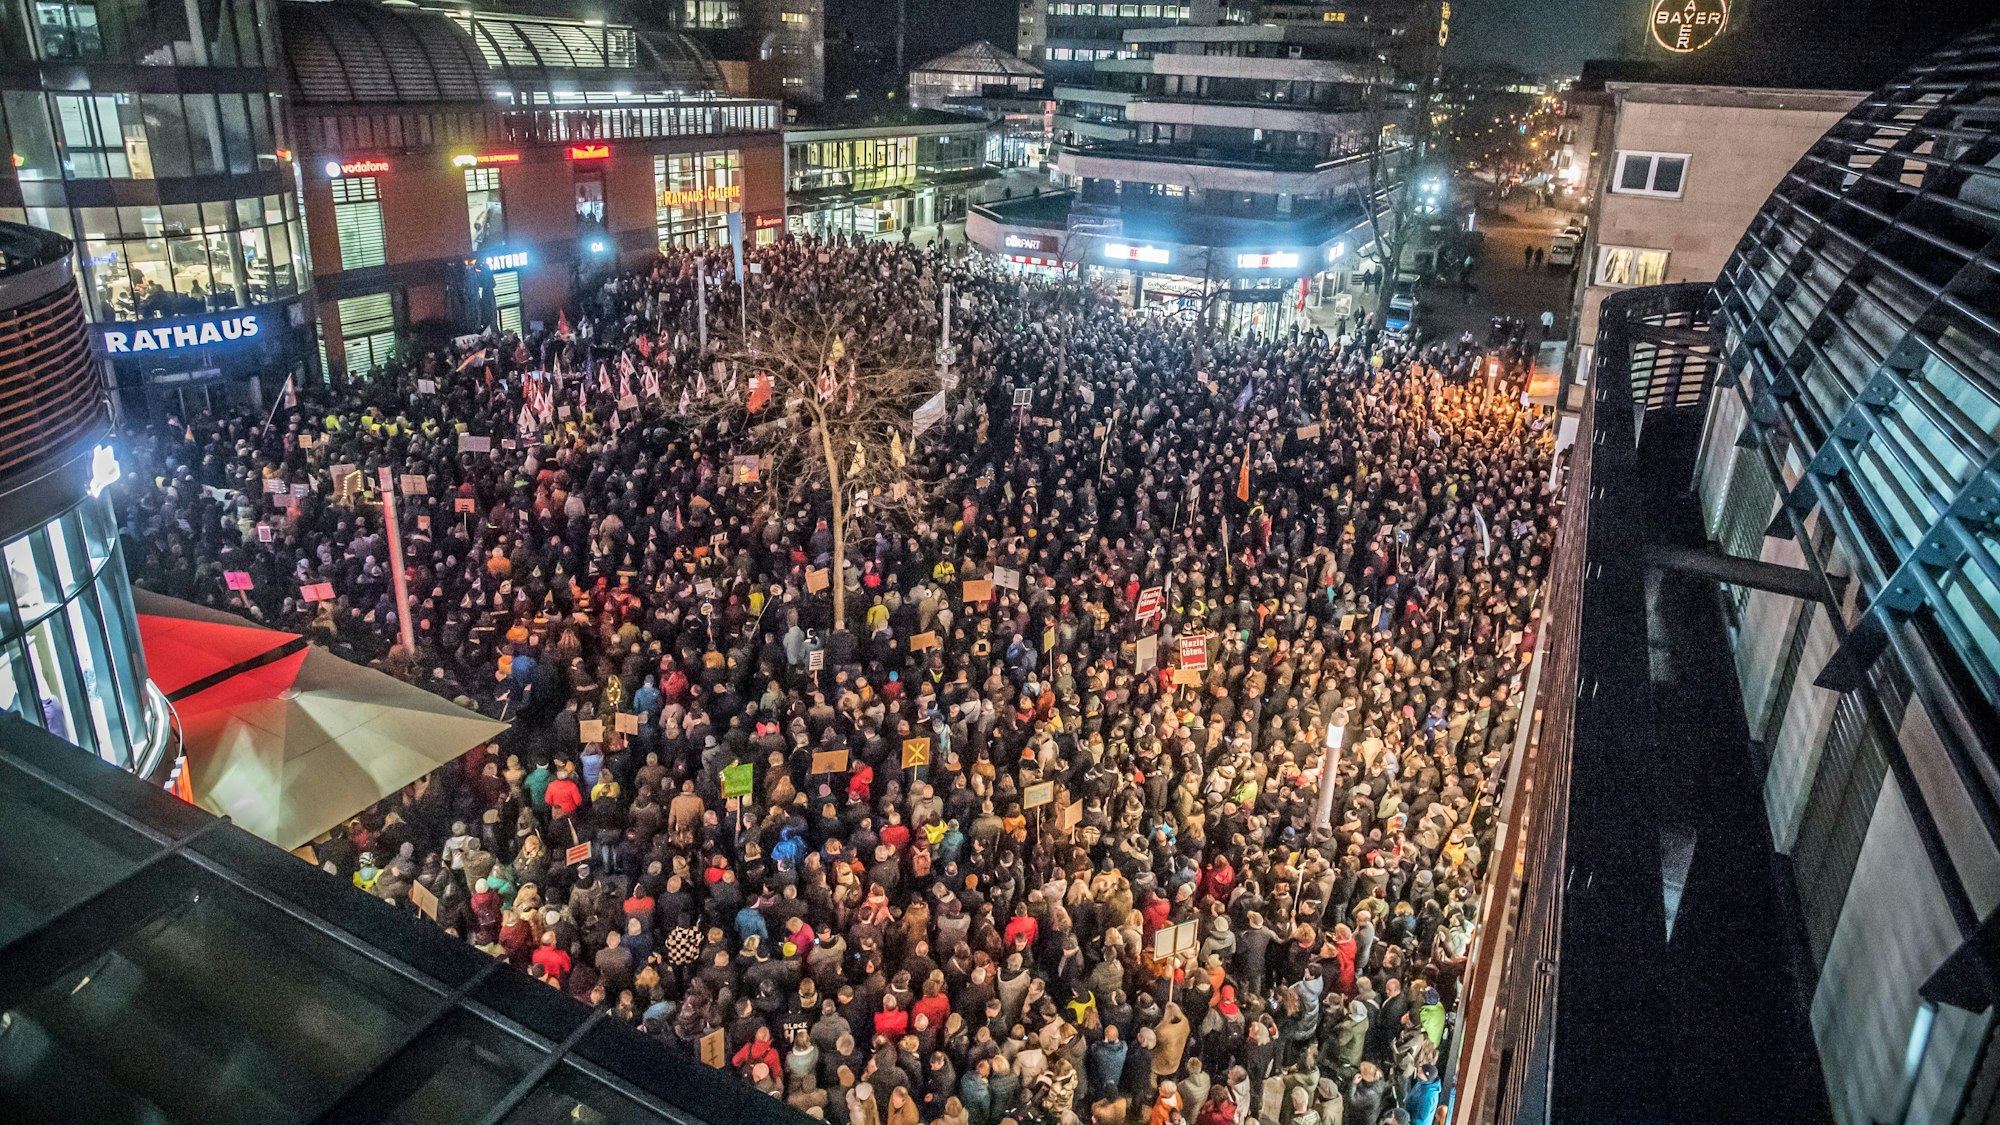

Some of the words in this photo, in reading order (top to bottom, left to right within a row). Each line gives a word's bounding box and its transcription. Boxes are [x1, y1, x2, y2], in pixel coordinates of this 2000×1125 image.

[1656, 11, 1721, 24] BAYER
[1676, 0, 1697, 48] AYER
[341, 160, 389, 173] vodafone
[664, 189, 704, 206] RATHAUS
[707, 185, 740, 201] GALERIE
[486, 253, 527, 270] SATURN
[104, 315, 259, 353] RATHAUS
[1142, 591, 1159, 600] Nazis
[1181, 638, 1204, 649] Nazis
[1182, 647, 1204, 657] töten.
